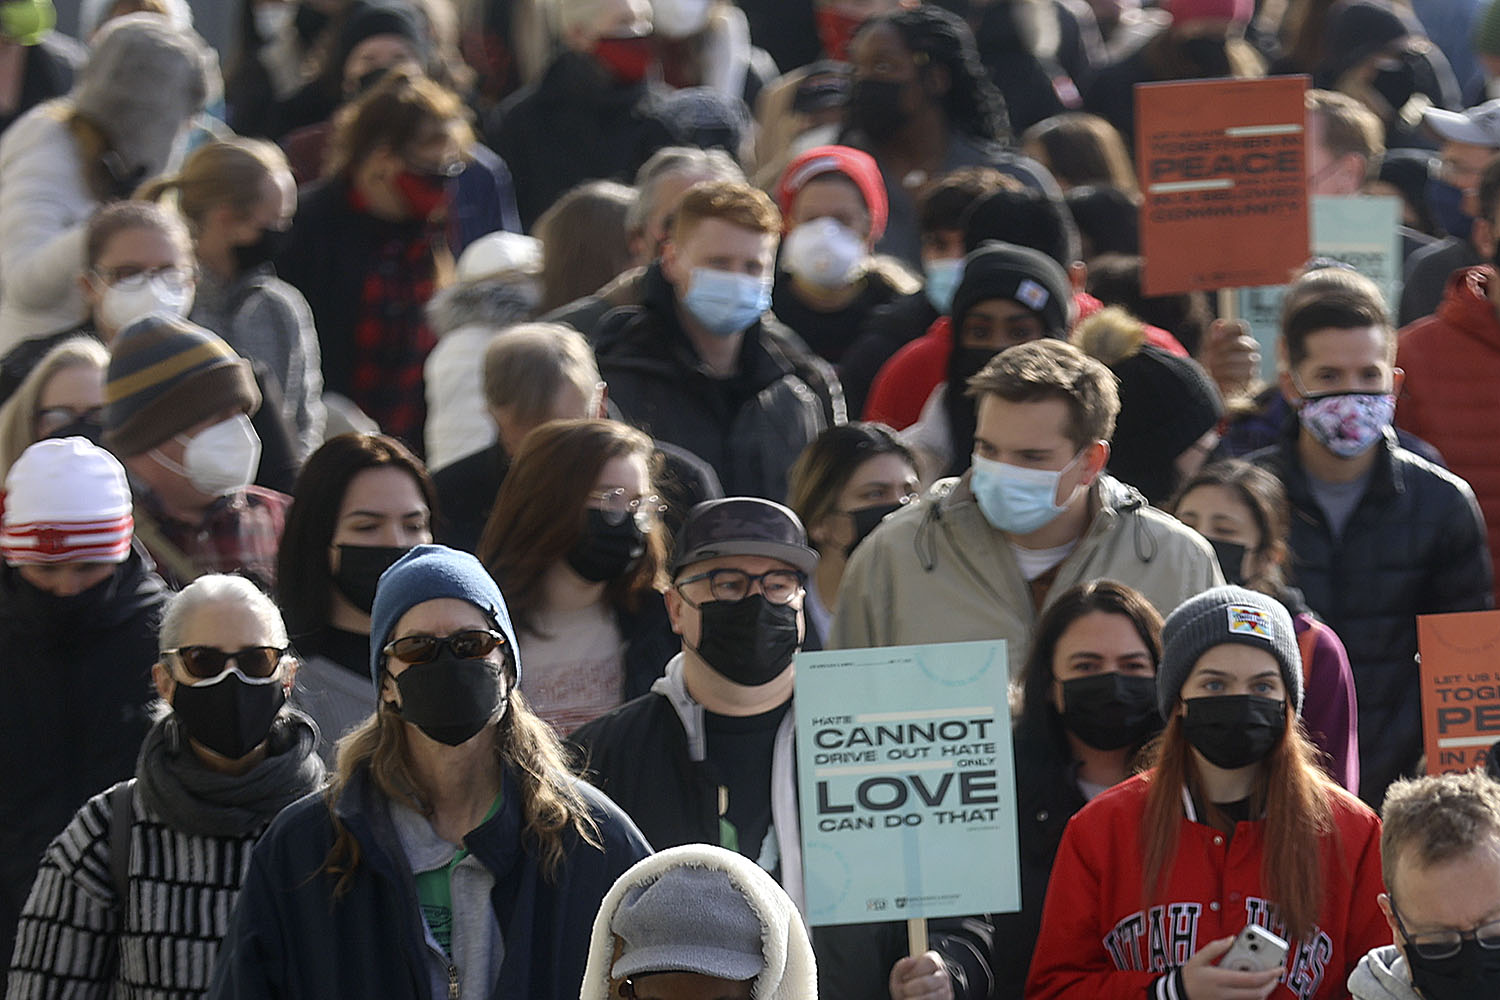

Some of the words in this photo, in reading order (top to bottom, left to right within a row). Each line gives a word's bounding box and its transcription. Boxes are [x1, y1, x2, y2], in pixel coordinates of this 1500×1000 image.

[1153, 150, 1300, 180] PEACE
[1433, 675, 1463, 685] LET
[1467, 673, 1490, 681] US
[812, 715, 852, 726] HATE
[815, 719, 994, 749] CANNOT
[815, 751, 876, 766] DRIVE
[887, 747, 930, 761] OUT
[941, 743, 995, 757] HATE
[957, 758, 997, 767] ONLY
[1439, 751, 1464, 765] IN
[816, 770, 998, 815] LOVE
[818, 817, 874, 833] CAN
[884, 813, 922, 828] DO
[933, 808, 999, 824] THAT
[1103, 903, 1202, 973] UTAH
